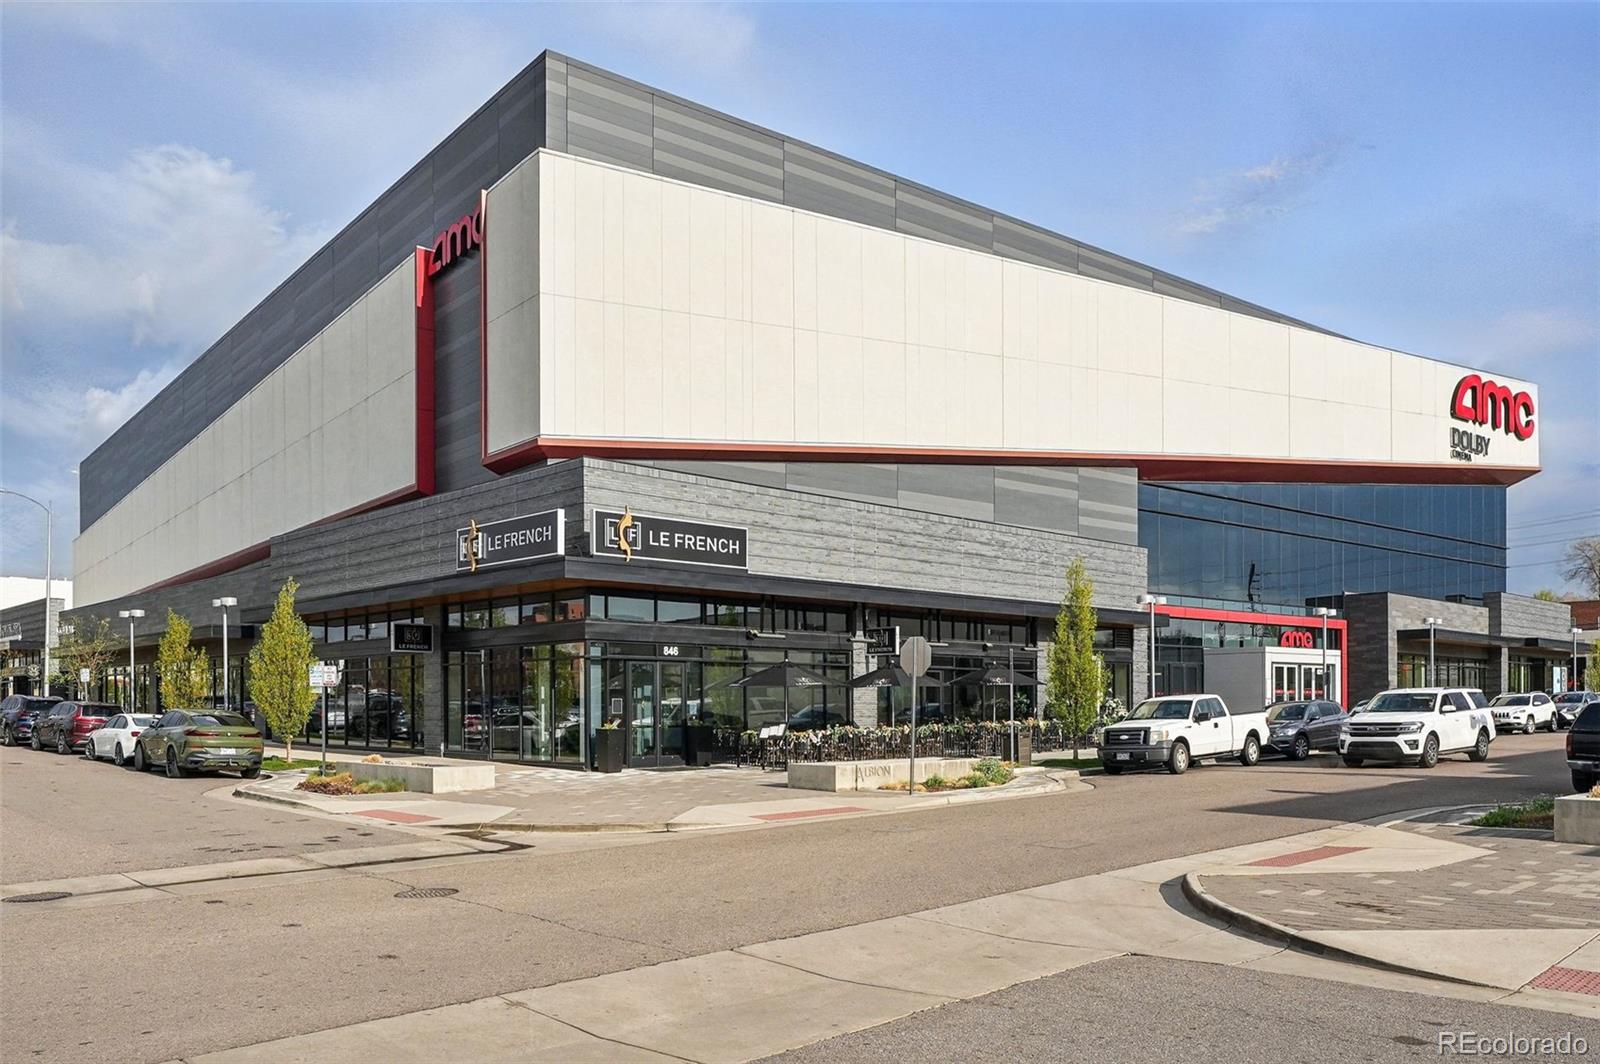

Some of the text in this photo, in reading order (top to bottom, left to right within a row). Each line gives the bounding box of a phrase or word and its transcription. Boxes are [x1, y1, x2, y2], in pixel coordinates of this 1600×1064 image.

[1450, 427, 1490, 457] DOLBY
[488, 535, 502, 551] LE
[503, 525, 552, 549] FRENCH
[649, 530, 740, 555] LE FRENCH
[663, 646, 679, 656] 846
